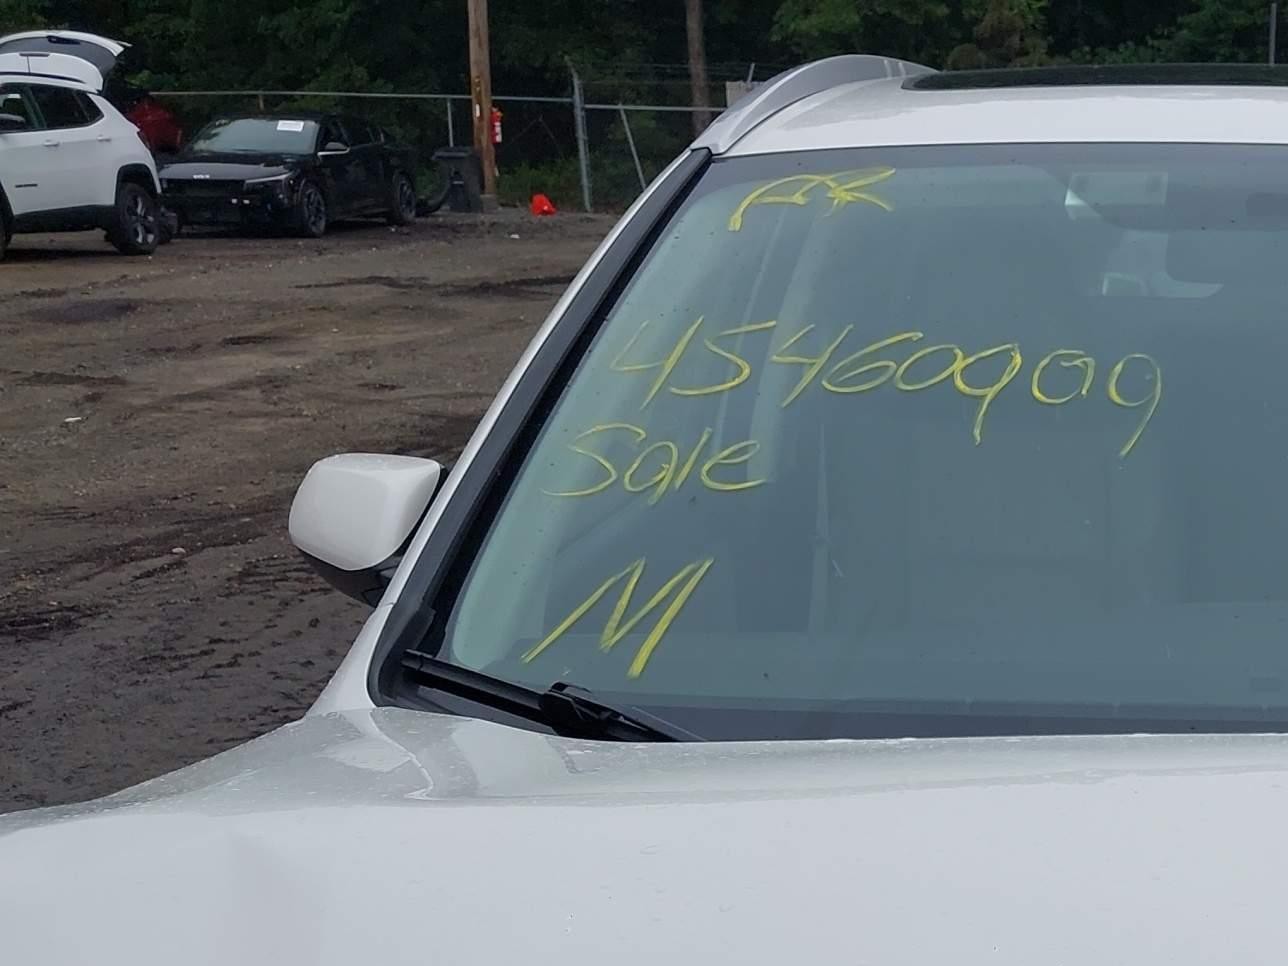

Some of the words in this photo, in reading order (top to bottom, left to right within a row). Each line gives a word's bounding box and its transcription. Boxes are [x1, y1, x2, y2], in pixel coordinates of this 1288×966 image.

[608, 315, 1163, 457] 45460909
[540, 422, 767, 505] Sale
[520, 556, 714, 680] M
